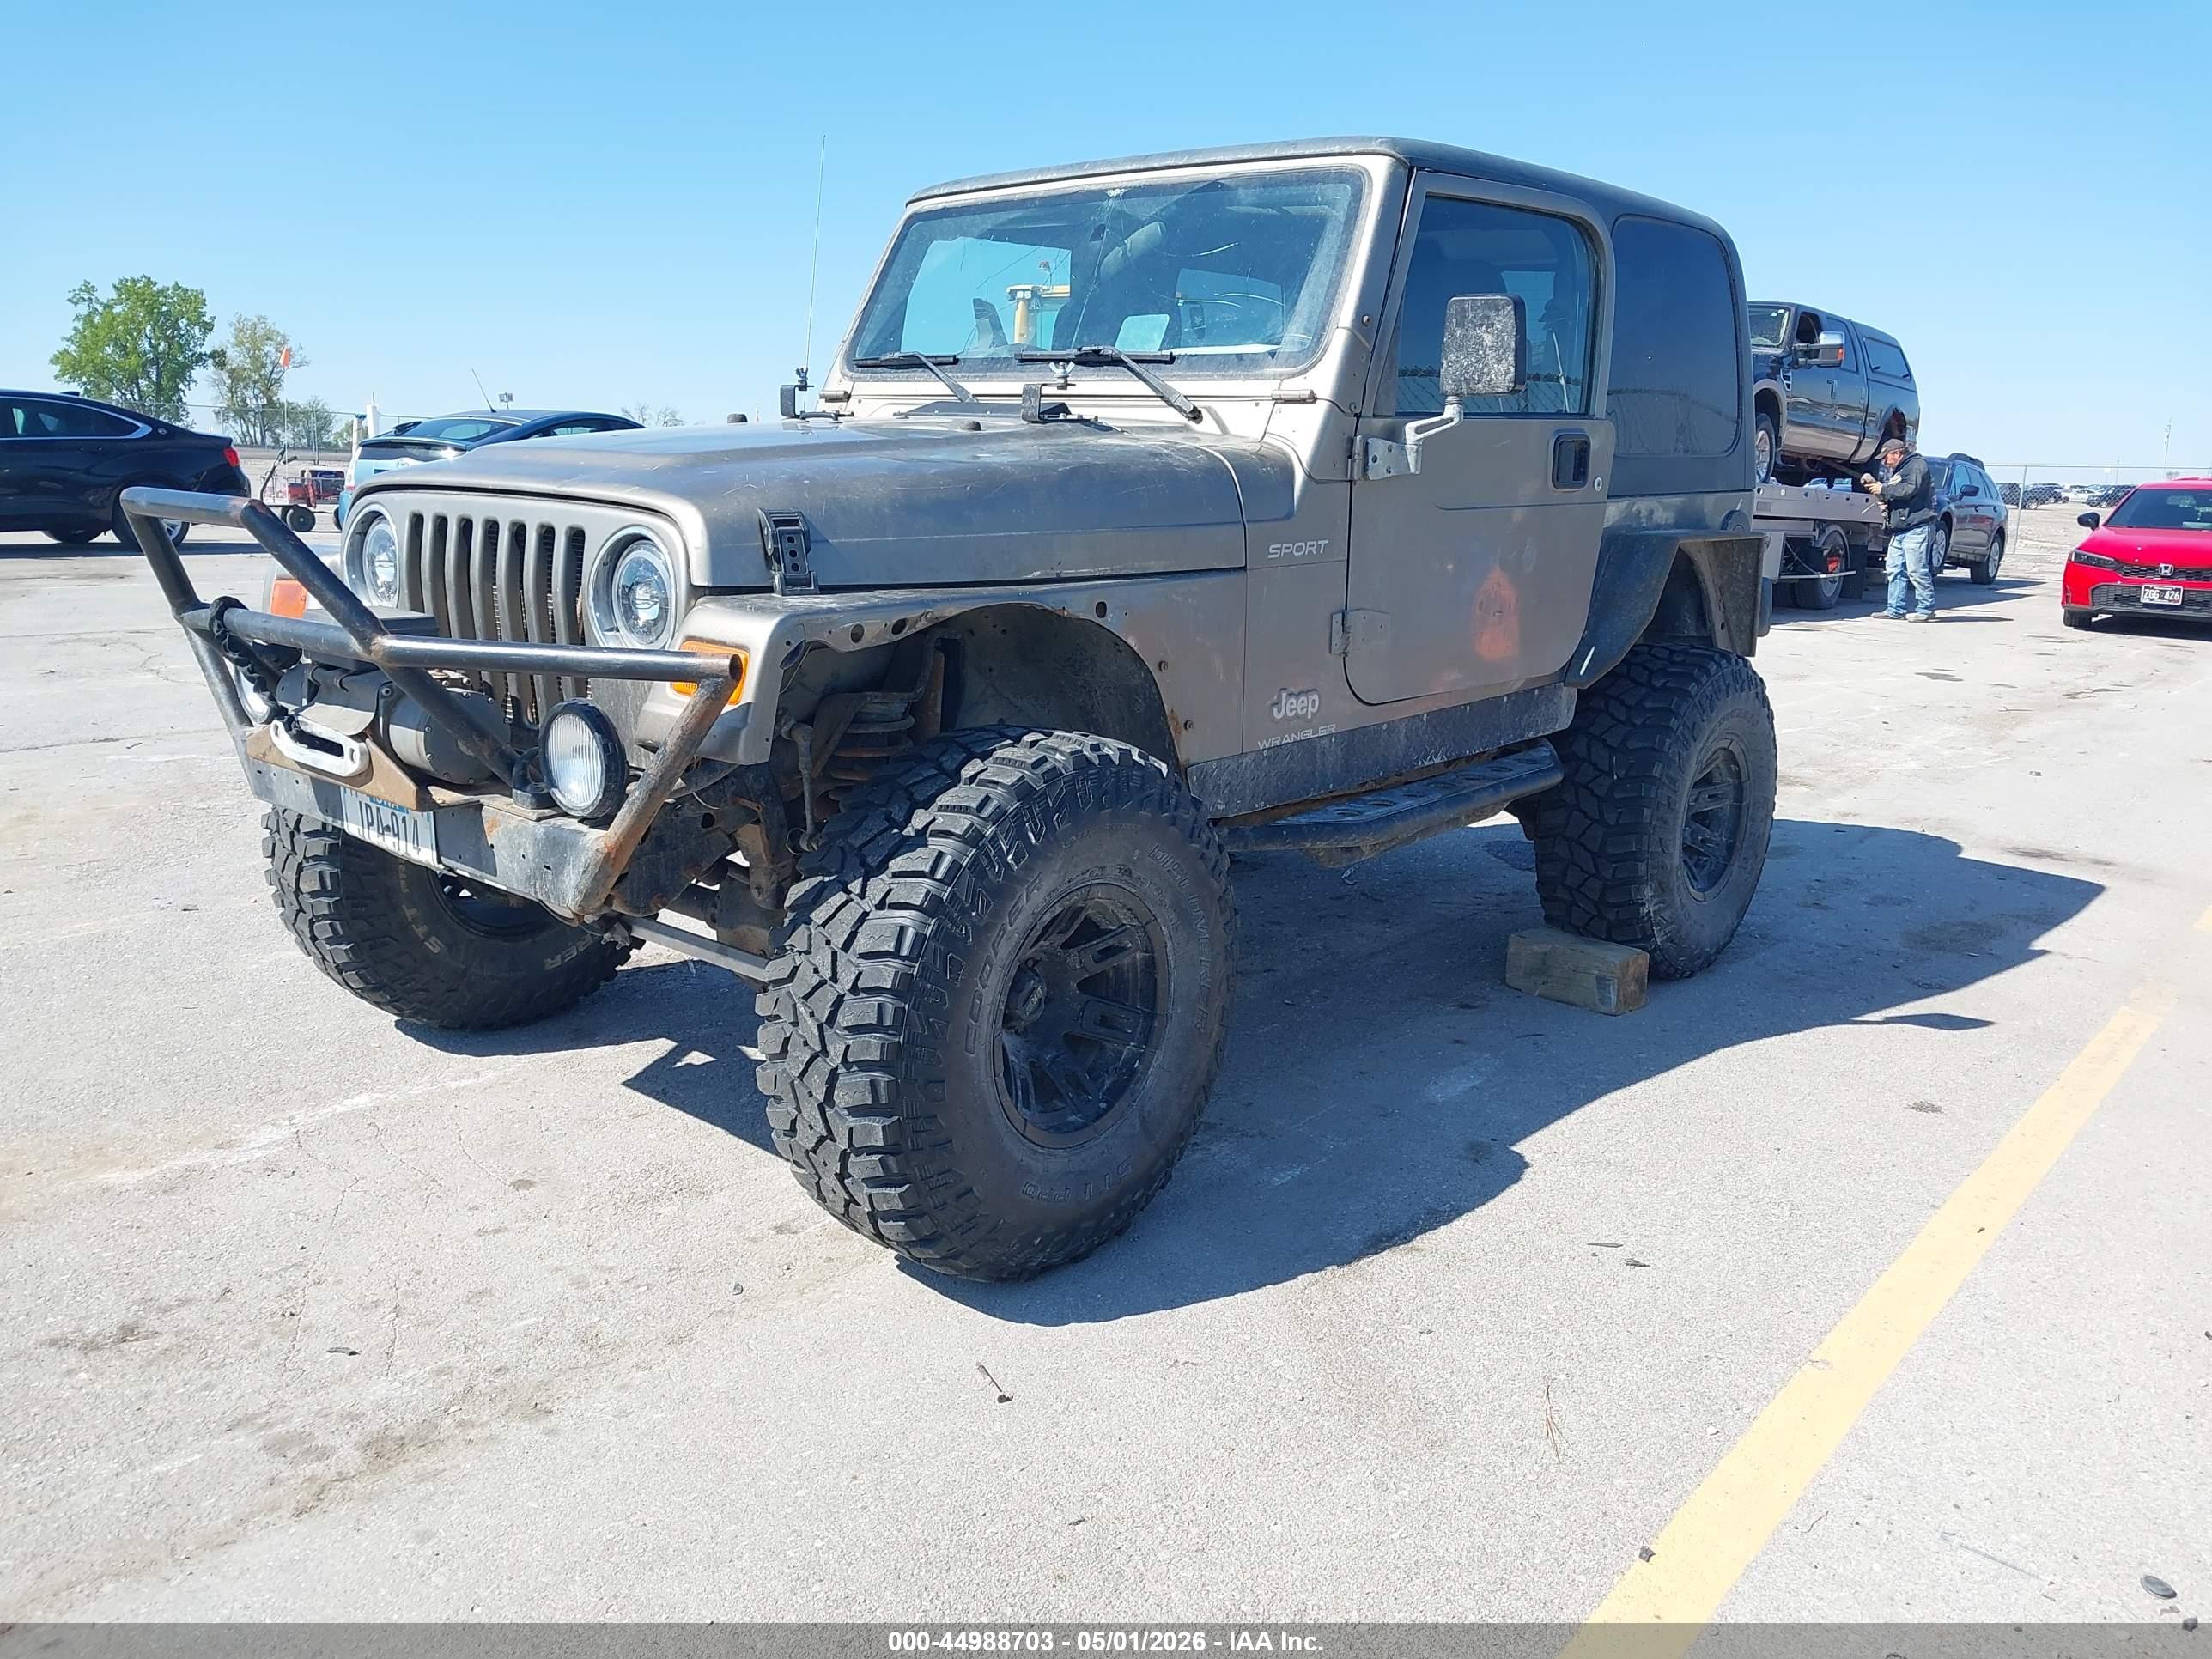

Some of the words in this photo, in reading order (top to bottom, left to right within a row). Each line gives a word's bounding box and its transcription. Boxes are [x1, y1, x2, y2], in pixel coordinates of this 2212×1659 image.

[1267, 539, 1329, 559] SPORT
[2164, 590, 2180, 600] 426
[1273, 691, 1320, 720] Jeep
[1257, 724, 1337, 750] WRANGLER
[359, 800, 386, 842] JPA
[391, 811, 421, 856] 914
[963, 871, 1042, 1057] COOPER
